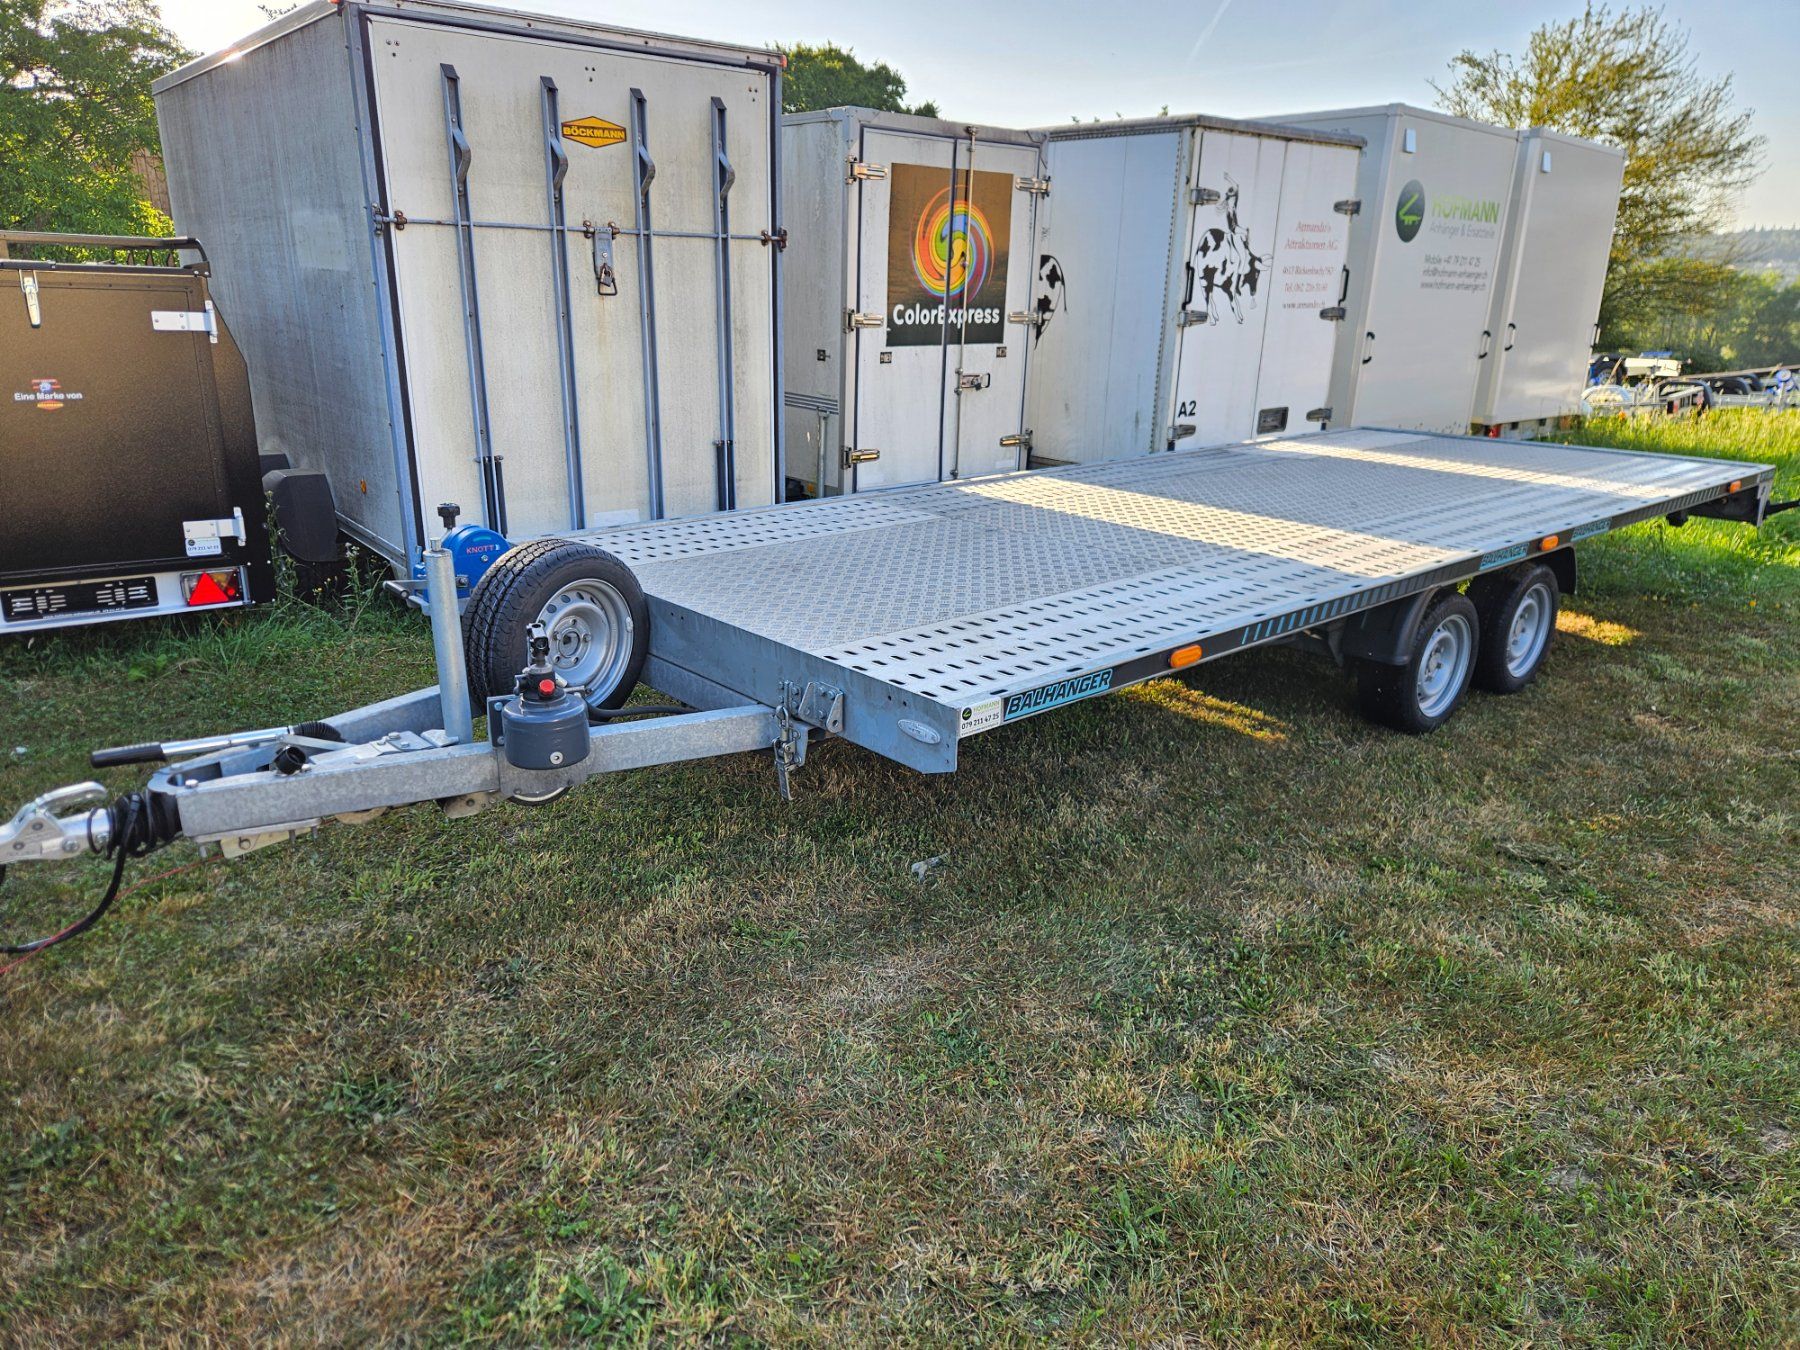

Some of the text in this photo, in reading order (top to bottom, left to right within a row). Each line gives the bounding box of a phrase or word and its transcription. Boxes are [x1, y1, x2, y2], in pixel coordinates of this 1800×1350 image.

[563, 126, 625, 139] BÖCKMANN
[1431, 195, 1500, 224] HOFMANN
[893, 302, 1001, 330] ColorExpress
[14, 392, 83, 401] Eine Marke von
[1178, 400, 1196, 418] A2
[466, 544, 494, 555] KNOTT
[1007, 669, 1112, 715] BALHANGER
[961, 720, 972, 730] 079
[974, 717, 983, 727] 211
[985, 714, 992, 722] 47
